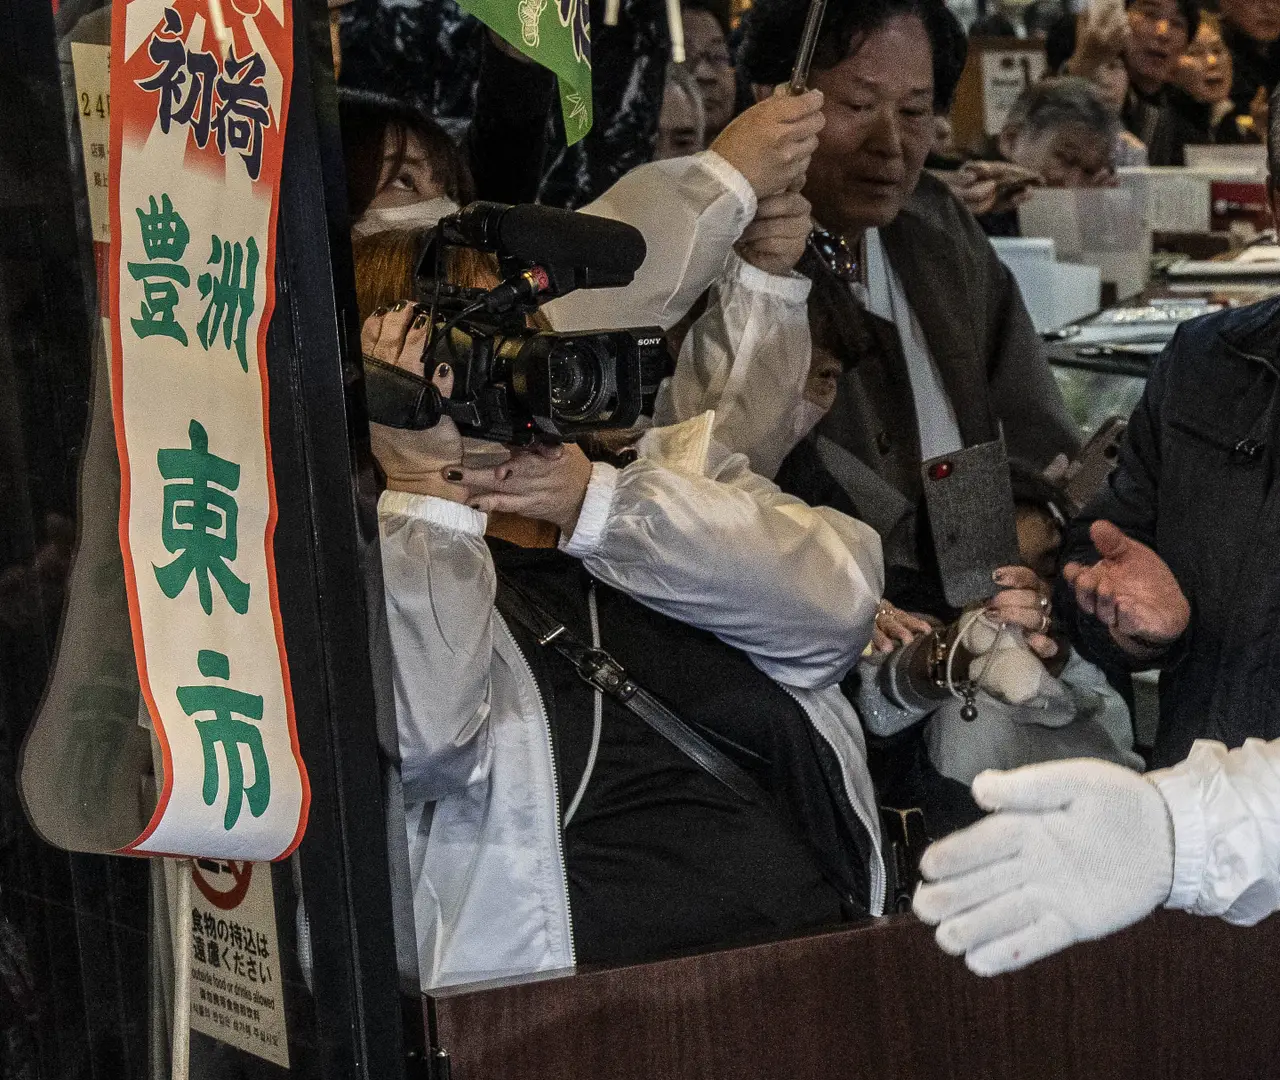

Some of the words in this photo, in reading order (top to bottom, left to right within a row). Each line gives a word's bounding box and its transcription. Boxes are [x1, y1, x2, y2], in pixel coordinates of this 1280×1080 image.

[135, 6, 270, 182] 初荷
[127, 193, 260, 372] 豊洲
[637, 338, 662, 346] SONY
